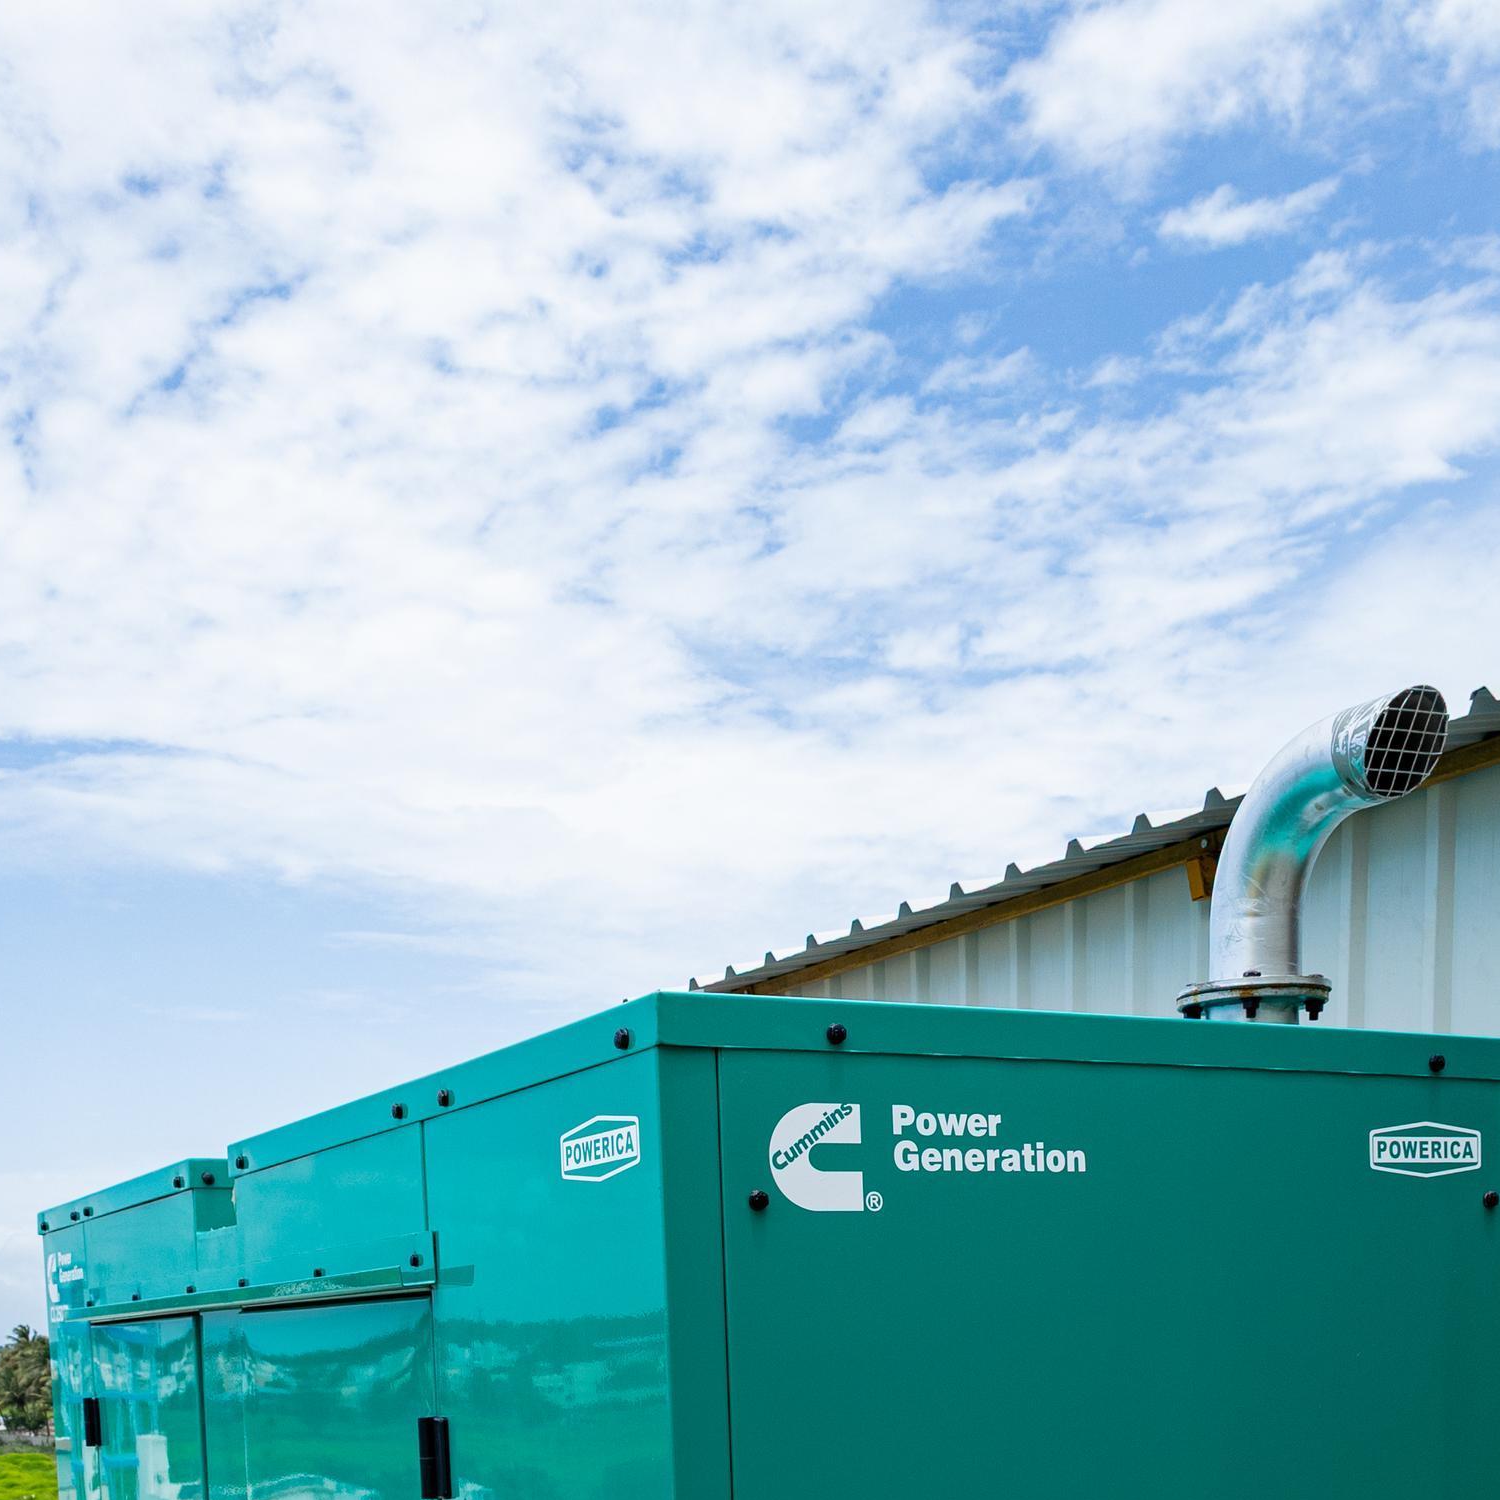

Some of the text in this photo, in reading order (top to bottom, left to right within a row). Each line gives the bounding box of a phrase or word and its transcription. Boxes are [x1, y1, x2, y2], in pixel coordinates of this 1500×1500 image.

[771, 1102, 854, 1171] Cummins
[891, 1103, 1002, 1137] Power
[564, 1130, 635, 1167] POWERICA
[893, 1139, 1087, 1173] Generation
[1376, 1140, 1475, 1160] POWERICA
